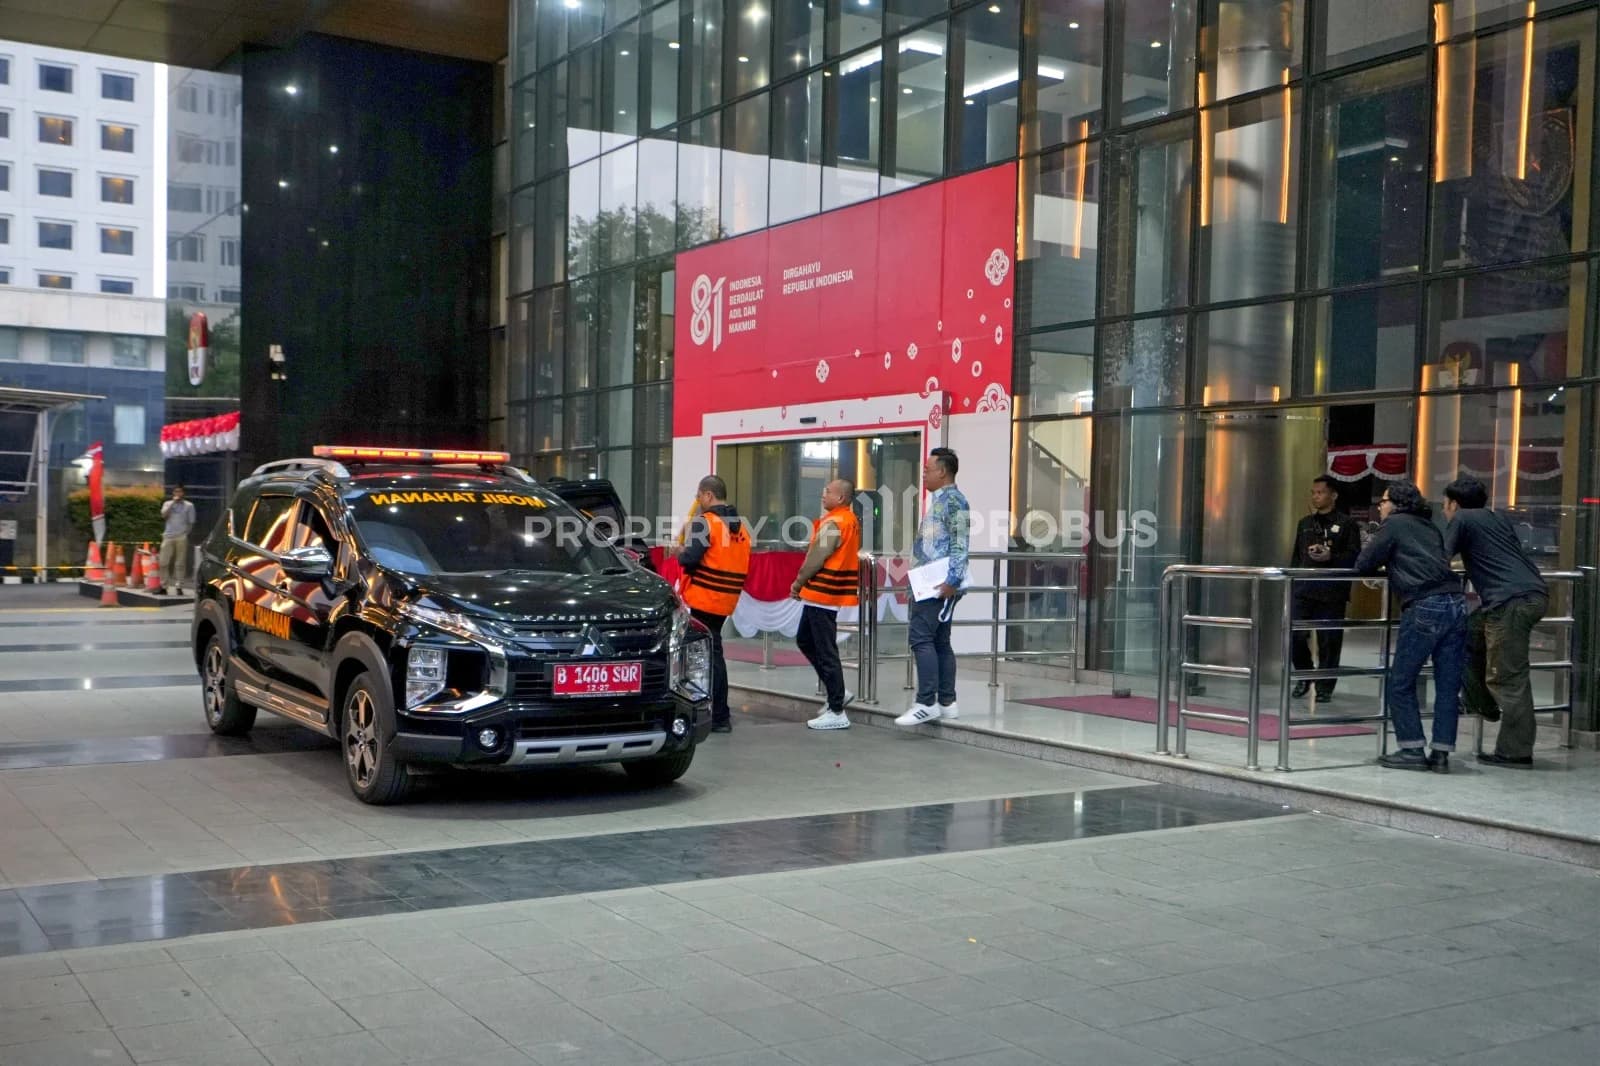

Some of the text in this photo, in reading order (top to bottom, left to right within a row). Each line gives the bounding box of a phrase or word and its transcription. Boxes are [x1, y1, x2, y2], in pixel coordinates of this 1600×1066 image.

[783, 261, 821, 280] DIRGAHAYU
[729, 275, 762, 292] INDONESIA
[783, 269, 854, 295] REPUBLIK INDONESIA
[729, 289, 764, 306] BERDAULAT
[690, 273, 727, 351] 81
[729, 305, 757, 321] ADIL DAN
[728, 319, 756, 334] MAKMUR
[522, 613, 597, 622] XPANDER
[557, 667, 567, 684] B
[574, 667, 608, 684] 1406
